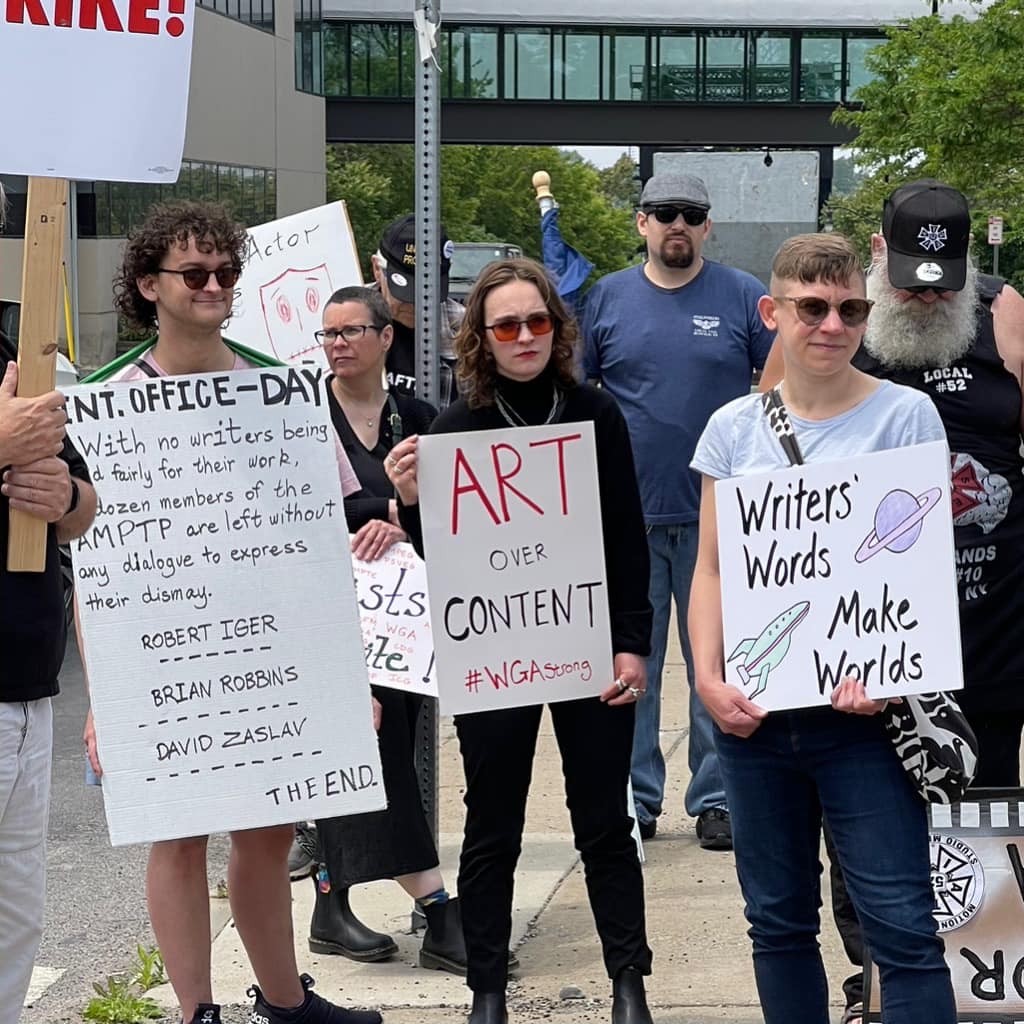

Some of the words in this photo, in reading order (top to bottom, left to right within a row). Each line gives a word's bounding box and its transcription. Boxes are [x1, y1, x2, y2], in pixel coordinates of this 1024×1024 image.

[248, 224, 319, 265] Actor
[387, 373, 416, 390] AFT
[923, 366, 973, 383] LOCAL
[936, 379, 967, 392] #52
[78, 427, 146, 457] With
[158, 437, 179, 451] no
[190, 418, 273, 446] writers
[283, 419, 327, 442] being
[111, 463, 153, 488] fairly
[158, 457, 183, 479] for
[193, 456, 235, 473] their
[248, 448, 299, 468] work,
[452, 434, 581, 535] ART
[96, 497, 150, 516] dozen
[160, 488, 233, 510] members
[245, 481, 264, 500] of
[274, 479, 312, 498] the
[736, 474, 859, 536] Writers'
[77, 518, 172, 551] AMPTP
[186, 519, 219, 537] are
[225, 510, 262, 532] left
[269, 500, 336, 525] without
[78, 564, 110, 587] any
[123, 550, 194, 578] dialogue
[202, 546, 221, 564] to
[230, 539, 308, 566] express
[489, 543, 549, 571] OVER
[743, 531, 831, 590] Words
[86, 593, 130, 611] their
[142, 584, 213, 609] dismay.
[355, 568, 426, 617] sts
[444, 581, 603, 641] CONTENT
[827, 583, 918, 640] Make
[141, 623, 212, 650] ROBERT
[220, 614, 278, 640] IGER
[151, 680, 212, 707] BRIAN
[220, 666, 299, 694] ROBBINS
[813, 641, 923, 696] Worlds
[156, 734, 213, 761] DAVID
[222, 717, 307, 748] ZASLAV
[266, 776, 318, 805] THE
[325, 764, 378, 797] END.
[946, 837, 977, 864] STUDIO
[941, 904, 976, 929] MOTION
